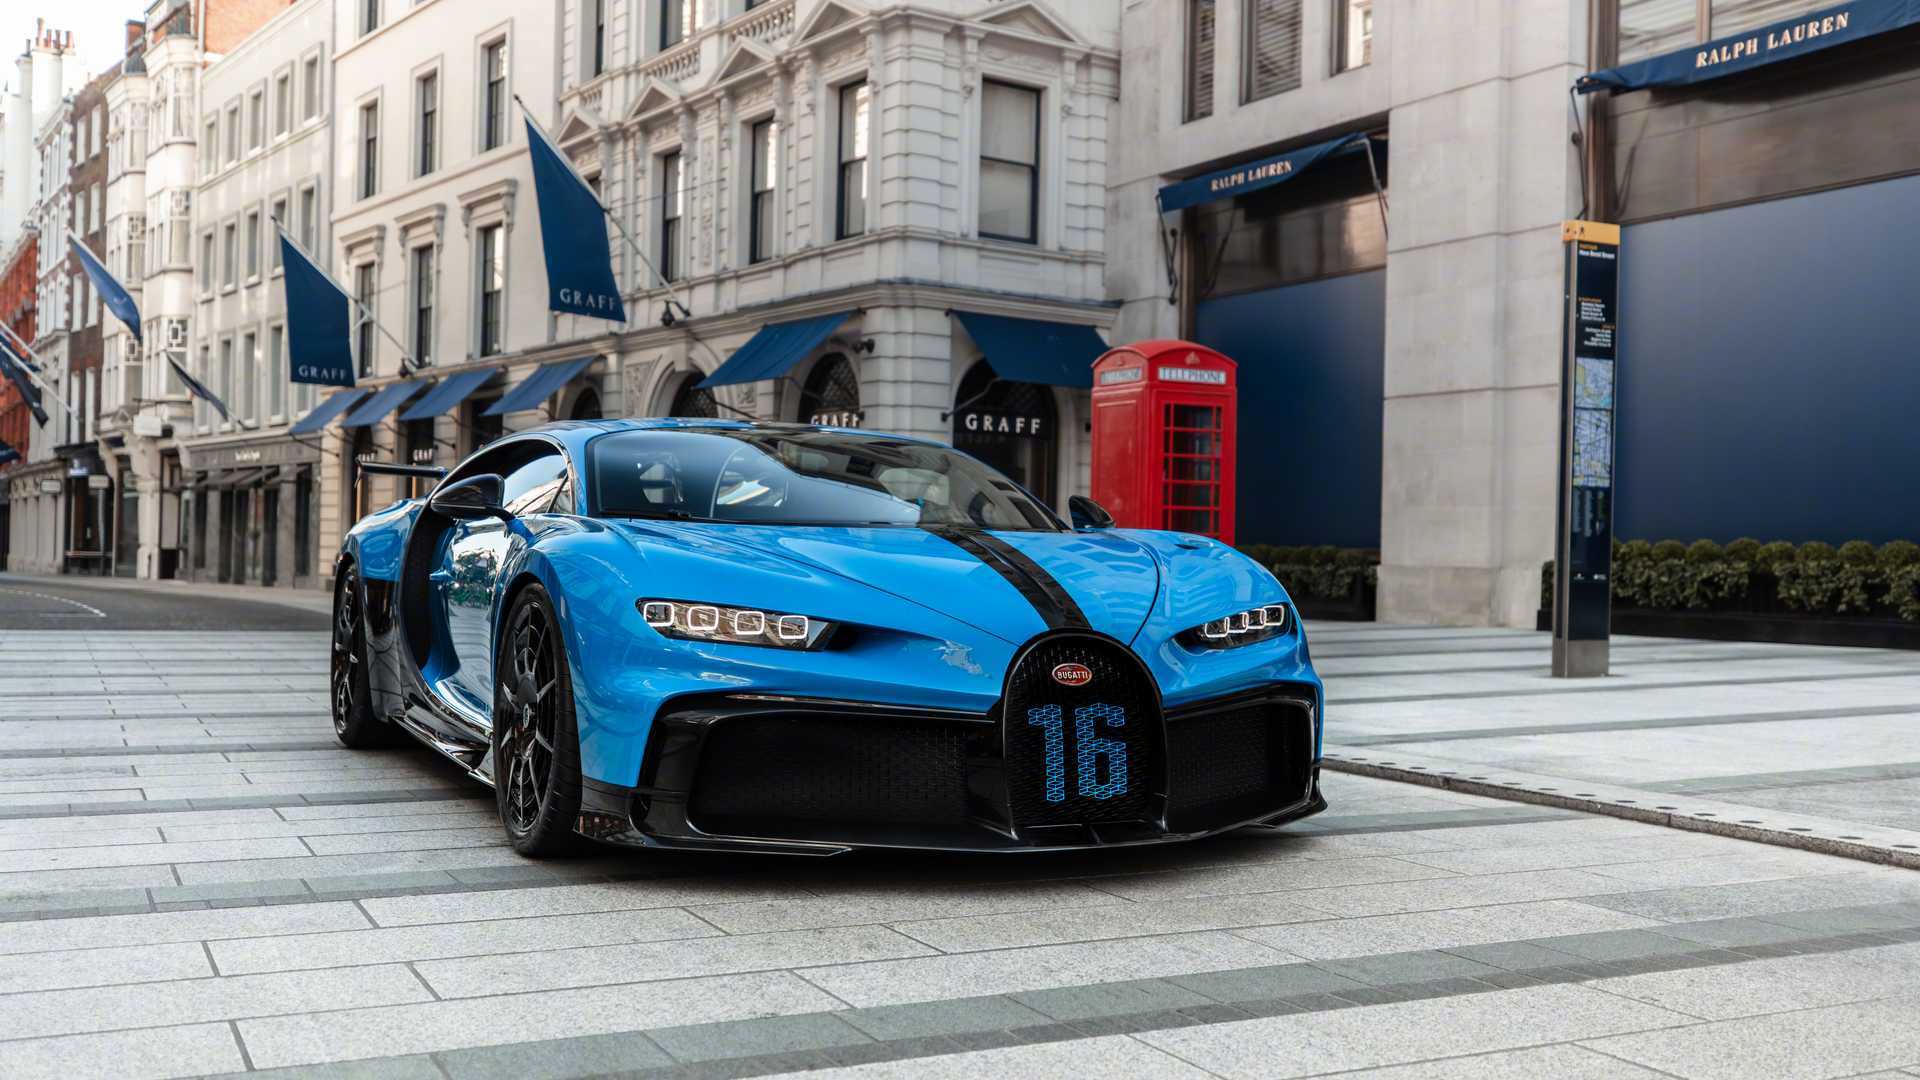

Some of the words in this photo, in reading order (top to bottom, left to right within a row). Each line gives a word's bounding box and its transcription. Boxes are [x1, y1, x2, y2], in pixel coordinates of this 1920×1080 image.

[1696, 37, 1759, 68] RALPH
[1767, 12, 1849, 49] LAUREN
[1211, 172, 1245, 192] RALPH
[1248, 160, 1292, 182] LAUREN
[560, 287, 616, 311] GRAFF
[298, 364, 347, 380] GRAFF
[1160, 368, 1223, 384] TELEPHONE
[965, 413, 1041, 435] GRAFF
[1057, 671, 1089, 680] BUGATTI
[1027, 702, 1127, 802] 16
